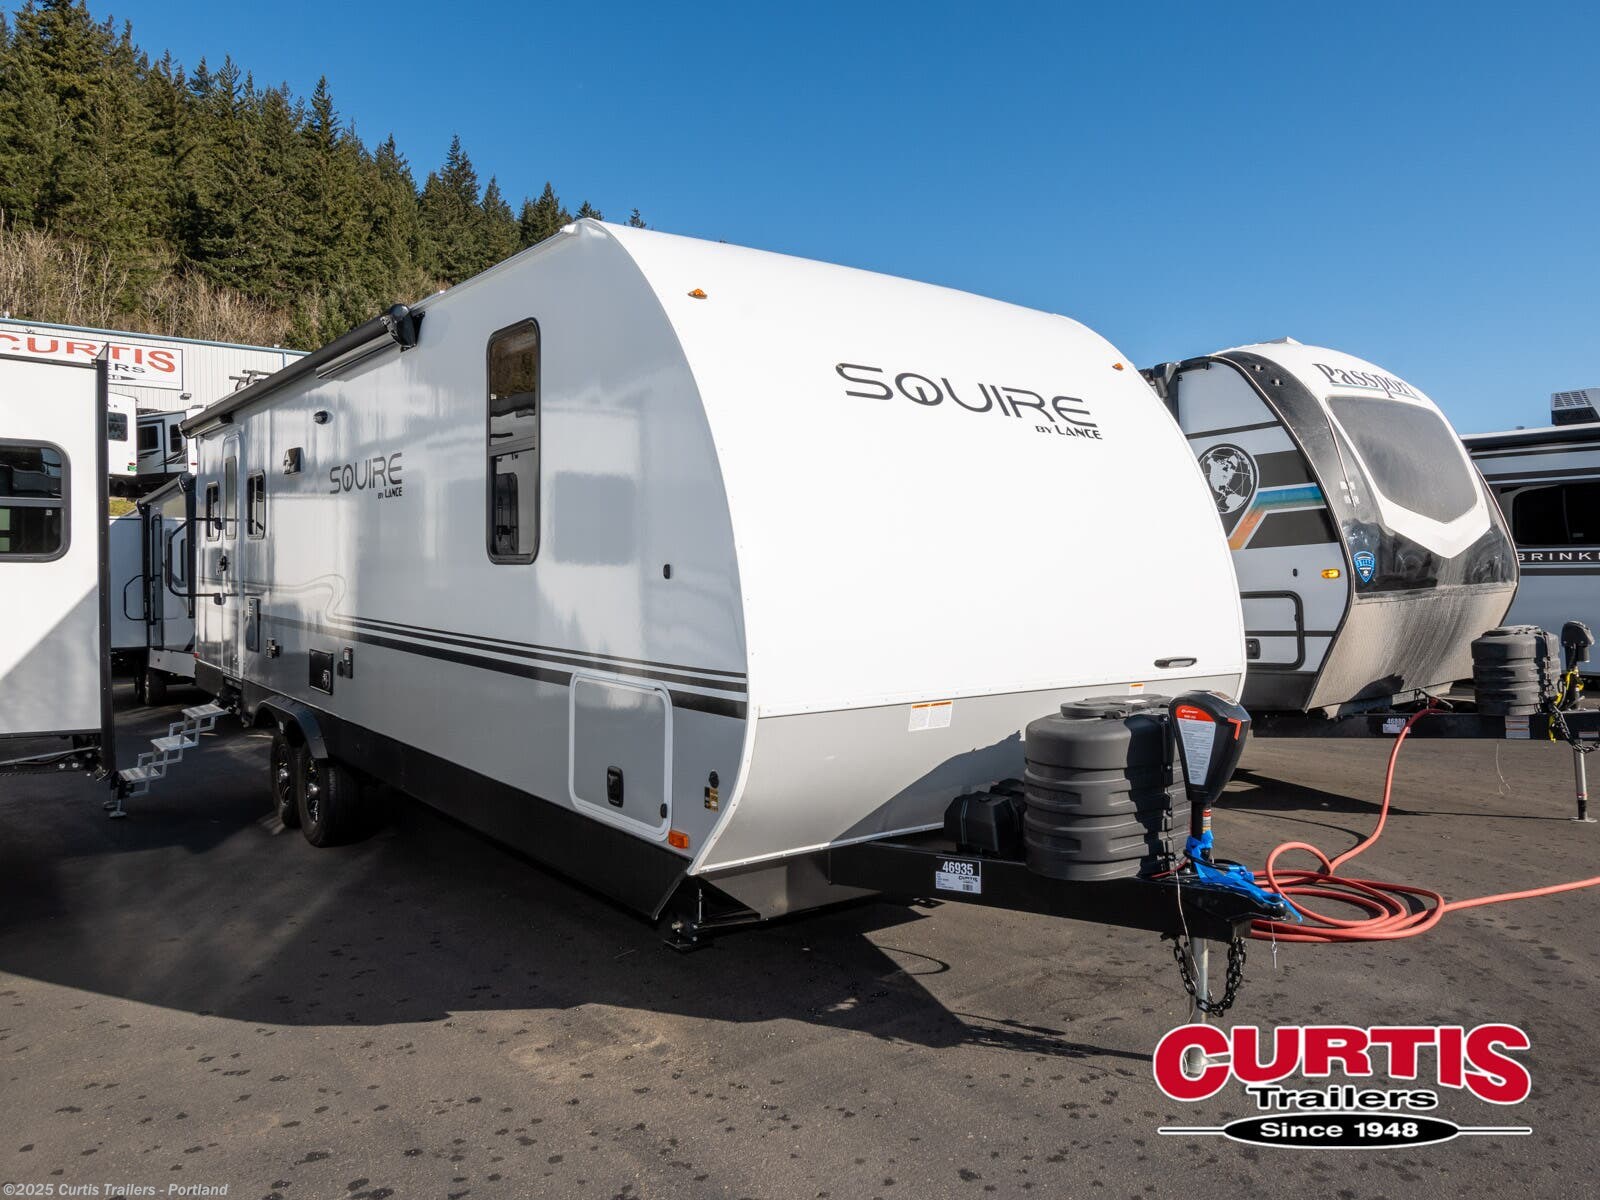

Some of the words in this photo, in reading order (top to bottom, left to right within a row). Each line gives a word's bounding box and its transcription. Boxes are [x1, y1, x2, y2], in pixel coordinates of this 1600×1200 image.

[836, 363, 1098, 428] SQUIRE
[1054, 424, 1103, 440] LANCE
[329, 452, 402, 494] SQUIRE
[385, 487, 402, 498] LANCE
[942, 861, 974, 876] 46935
